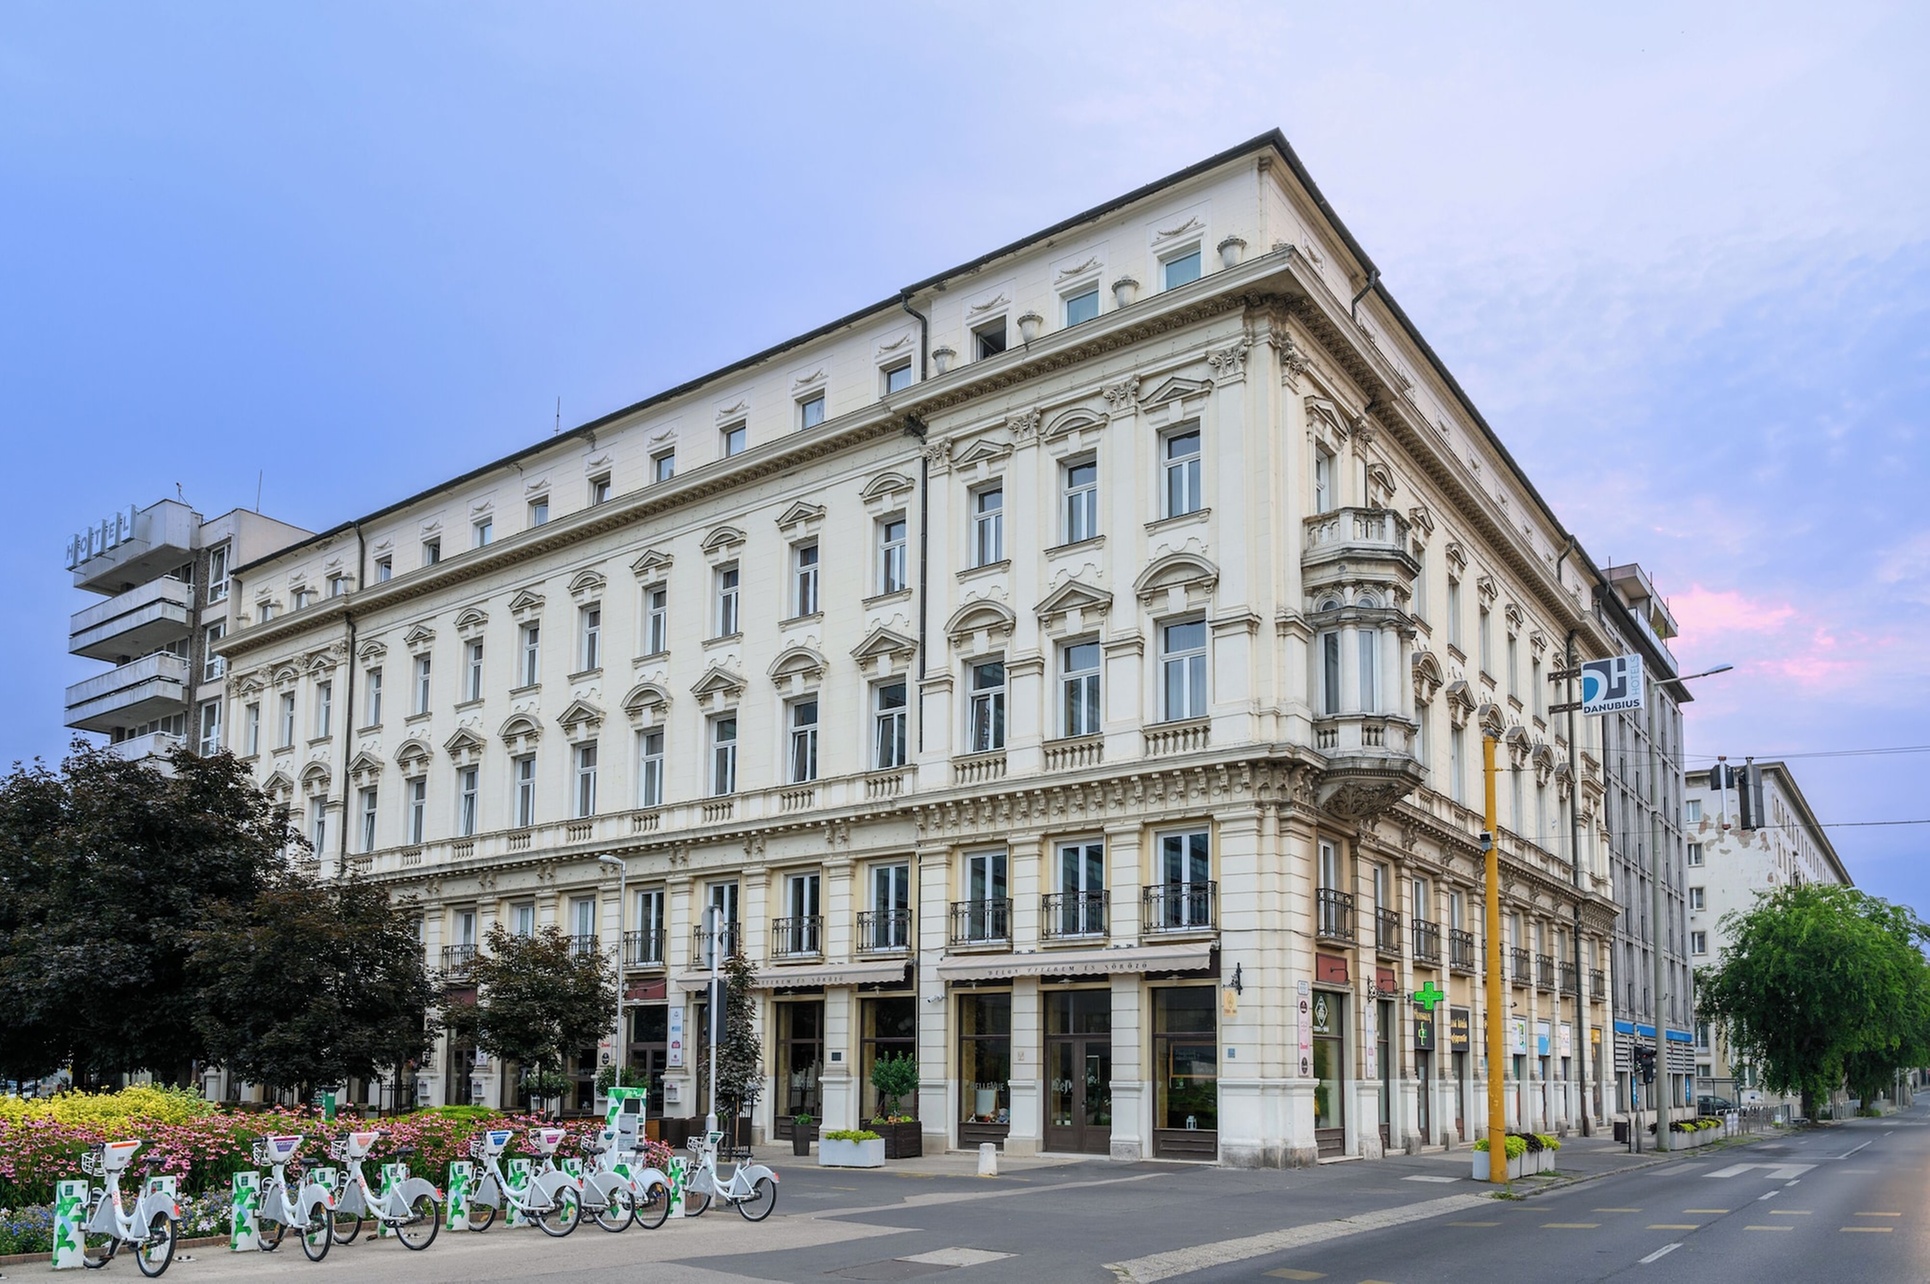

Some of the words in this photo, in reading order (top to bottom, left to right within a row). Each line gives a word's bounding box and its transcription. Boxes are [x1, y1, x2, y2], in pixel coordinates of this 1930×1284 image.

[66, 515, 129, 561] HOTEL
[1630, 655, 1640, 695] HOTELS
[1583, 699, 1640, 714] DANUBIUS
